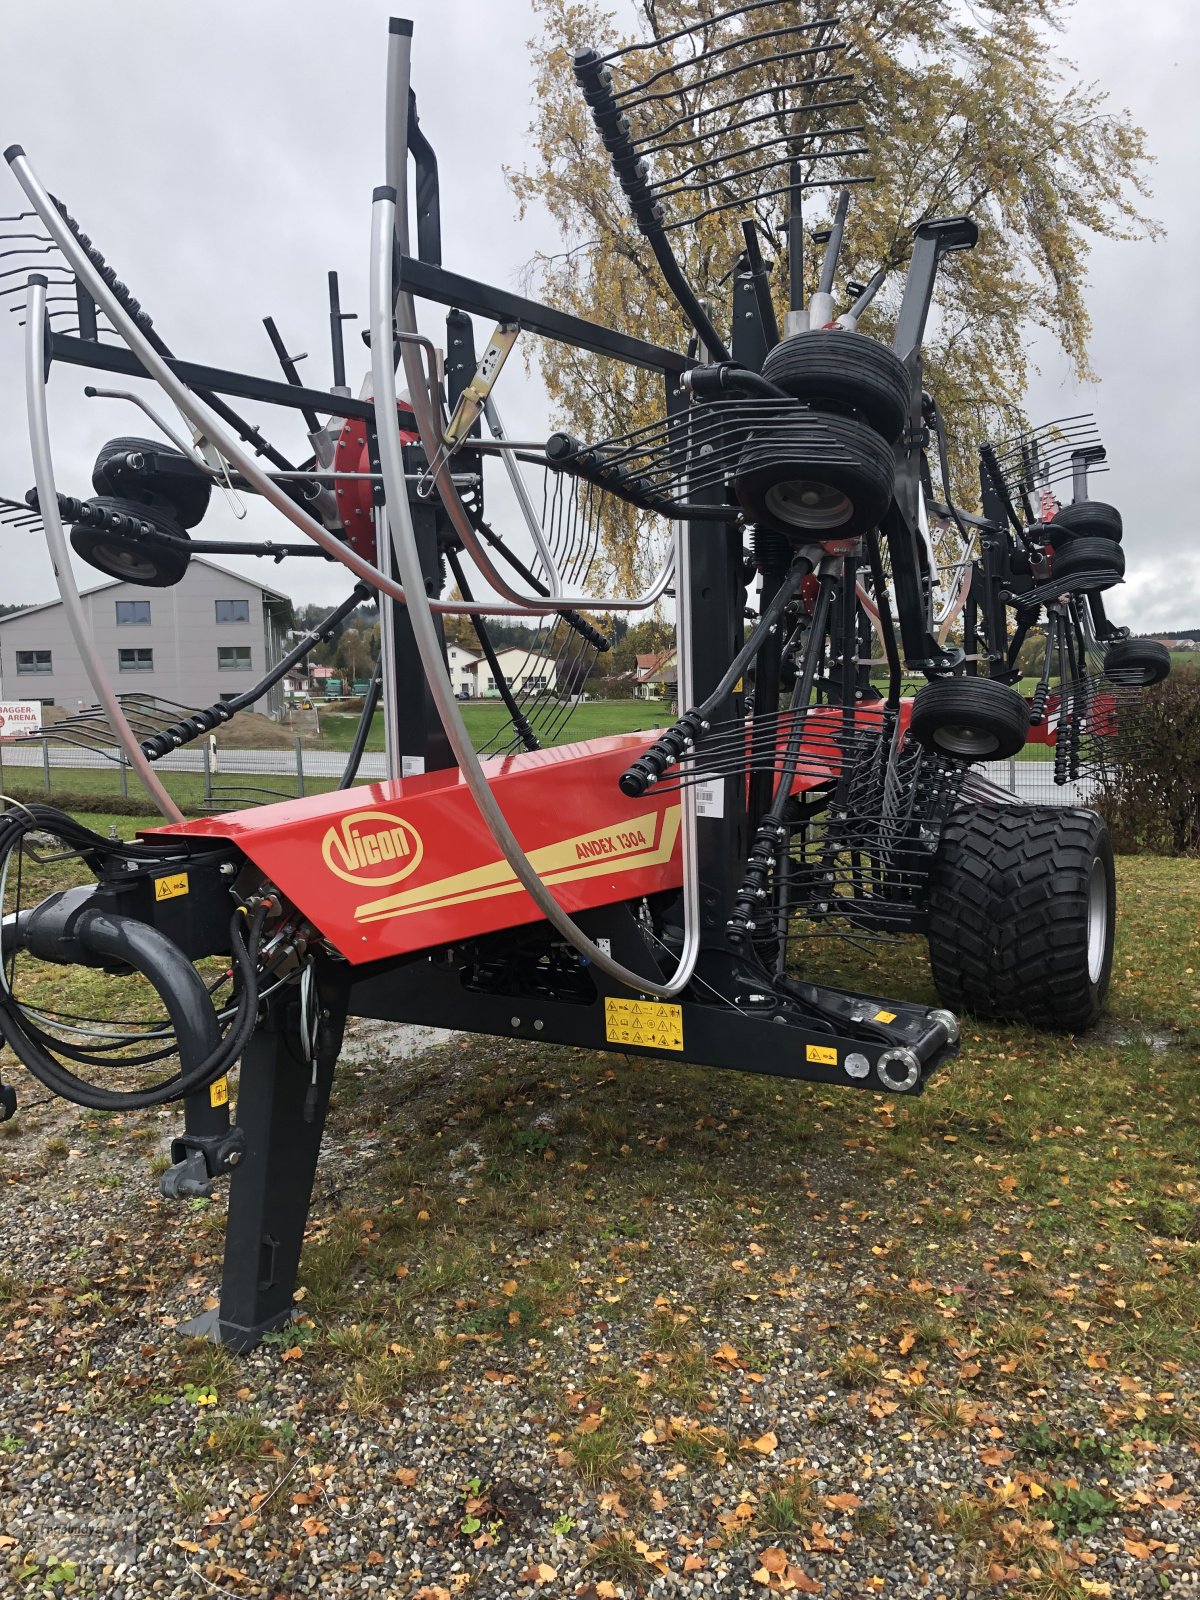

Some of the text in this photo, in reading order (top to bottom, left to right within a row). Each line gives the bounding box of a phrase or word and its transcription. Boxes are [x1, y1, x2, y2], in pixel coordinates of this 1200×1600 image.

[331, 813, 411, 871] Vicon
[575, 830, 647, 860] ANDEX 1304
